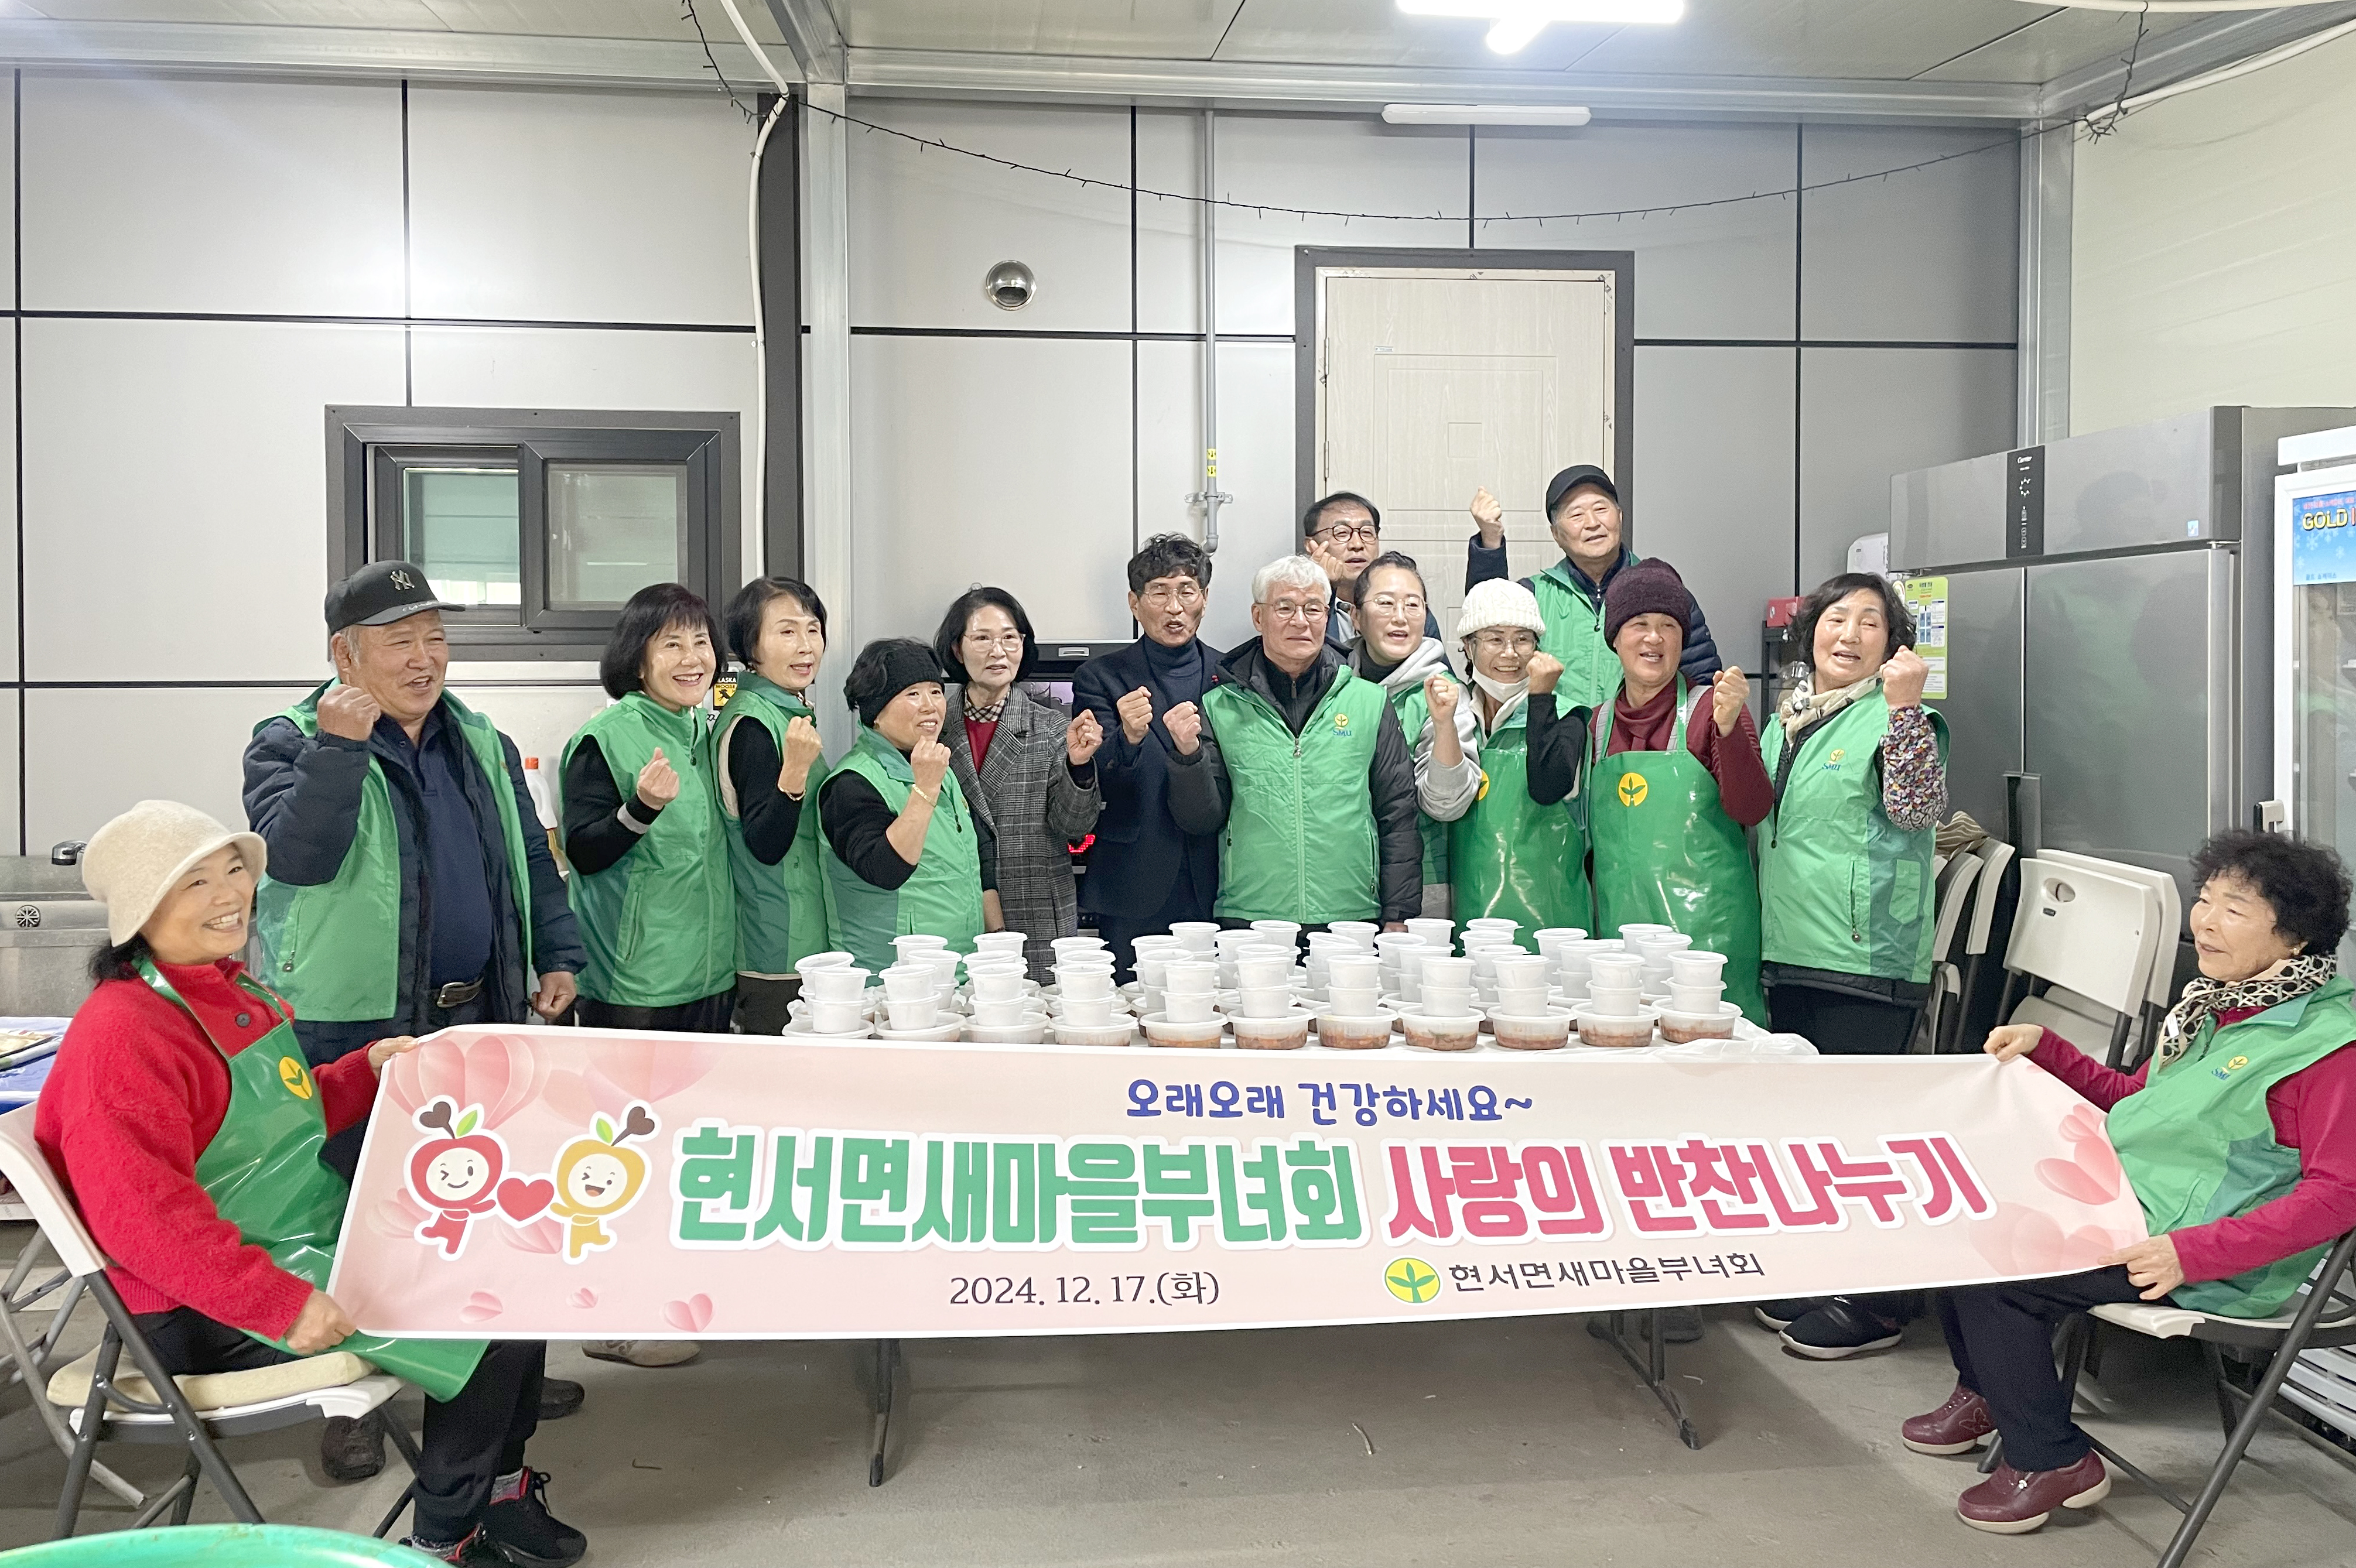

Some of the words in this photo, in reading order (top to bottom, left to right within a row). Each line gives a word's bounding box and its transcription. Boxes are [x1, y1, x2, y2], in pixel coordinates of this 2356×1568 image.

[2302, 508, 2348, 530] GOLD
[1127, 1079, 1285, 1119] 오래오래
[1298, 1083, 1533, 1127] 건강하세요~
[679, 1127, 1362, 1243] 현서면새마을부녀회
[1388, 1145, 1604, 1239] 사랑의
[1608, 1137, 1988, 1231] 반찬나누기
[949, 1276, 1045, 1306] 2024.
[1056, 1276, 1100, 1305] 12.
[1110, 1271, 1220, 1306] 17.(화)
[1448, 1252, 1765, 1292] 현서면새마을부녀회
